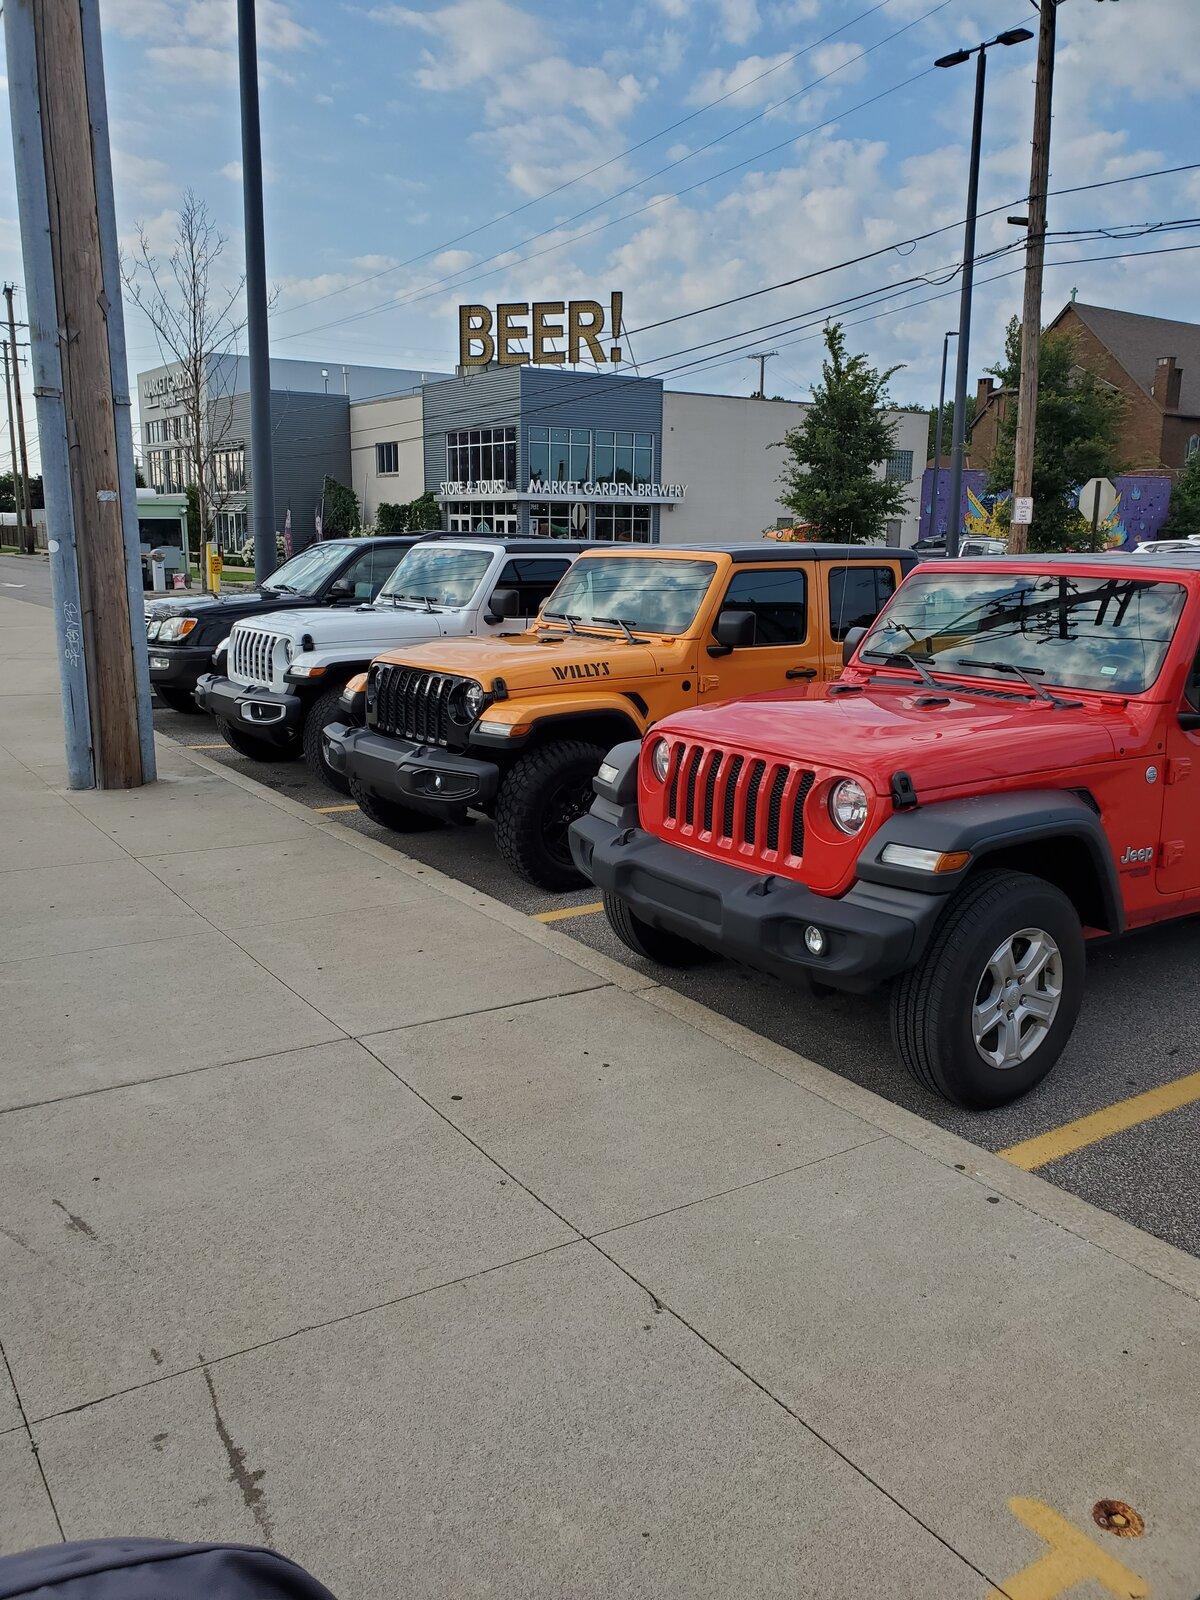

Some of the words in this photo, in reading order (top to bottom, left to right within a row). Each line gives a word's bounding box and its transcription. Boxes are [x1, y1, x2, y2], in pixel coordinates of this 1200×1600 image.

[459, 291, 622, 366] BEER!
[440, 481, 464, 495] STORE
[466, 481, 473, 494] &
[476, 479, 504, 494] TOURS
[528, 479, 581, 494] MARKET
[583, 481, 635, 496] GARDEN
[638, 483, 688, 498] BREWERY
[551, 661, 610, 680] WILLYS
[1120, 846, 1154, 864] Jeep
